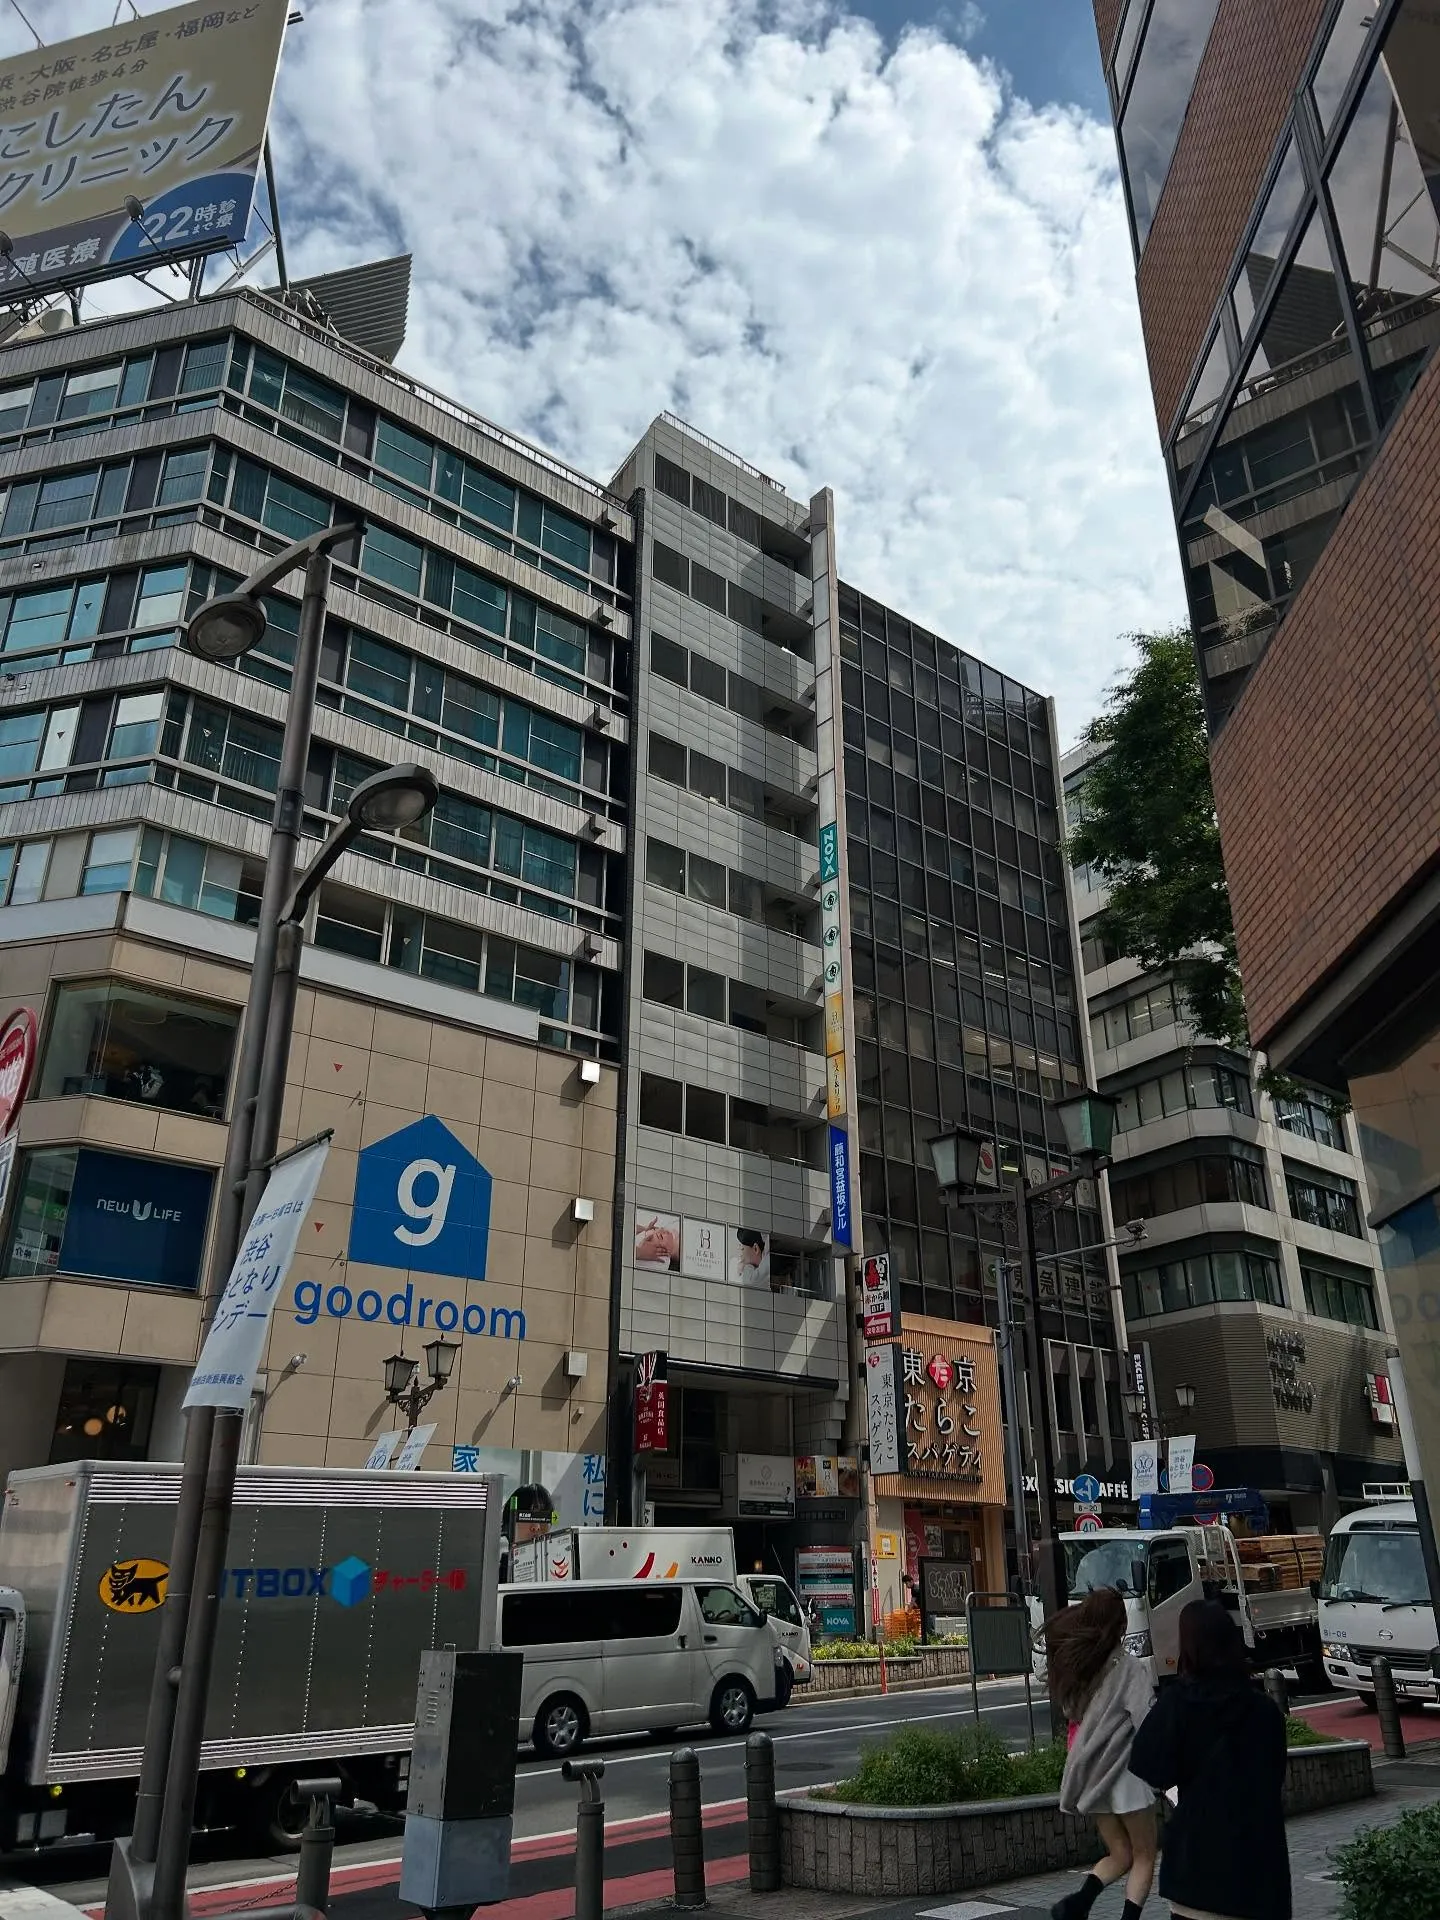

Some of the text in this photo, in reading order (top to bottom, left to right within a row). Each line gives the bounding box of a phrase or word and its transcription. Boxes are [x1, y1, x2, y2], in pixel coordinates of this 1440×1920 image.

[0, 76, 208, 160] にしたん
[0, 117, 234, 210] クリニック
[823, 829, 835, 878] NOVA
[154, 1208, 182, 1223] LIFE
[393, 1158, 457, 1246] g
[293, 1280, 527, 1341] goodroom
[871, 1393, 883, 1466] スパゲティ
[880, 1373, 895, 1460] 東京たらこ
[904, 1393, 981, 1436] たらこ
[452, 1445, 480, 1473] 家
[907, 1441, 983, 1470] スパゲティ
[691, 1556, 722, 1565] KANNO
[826, 1617, 850, 1626] NOVA
